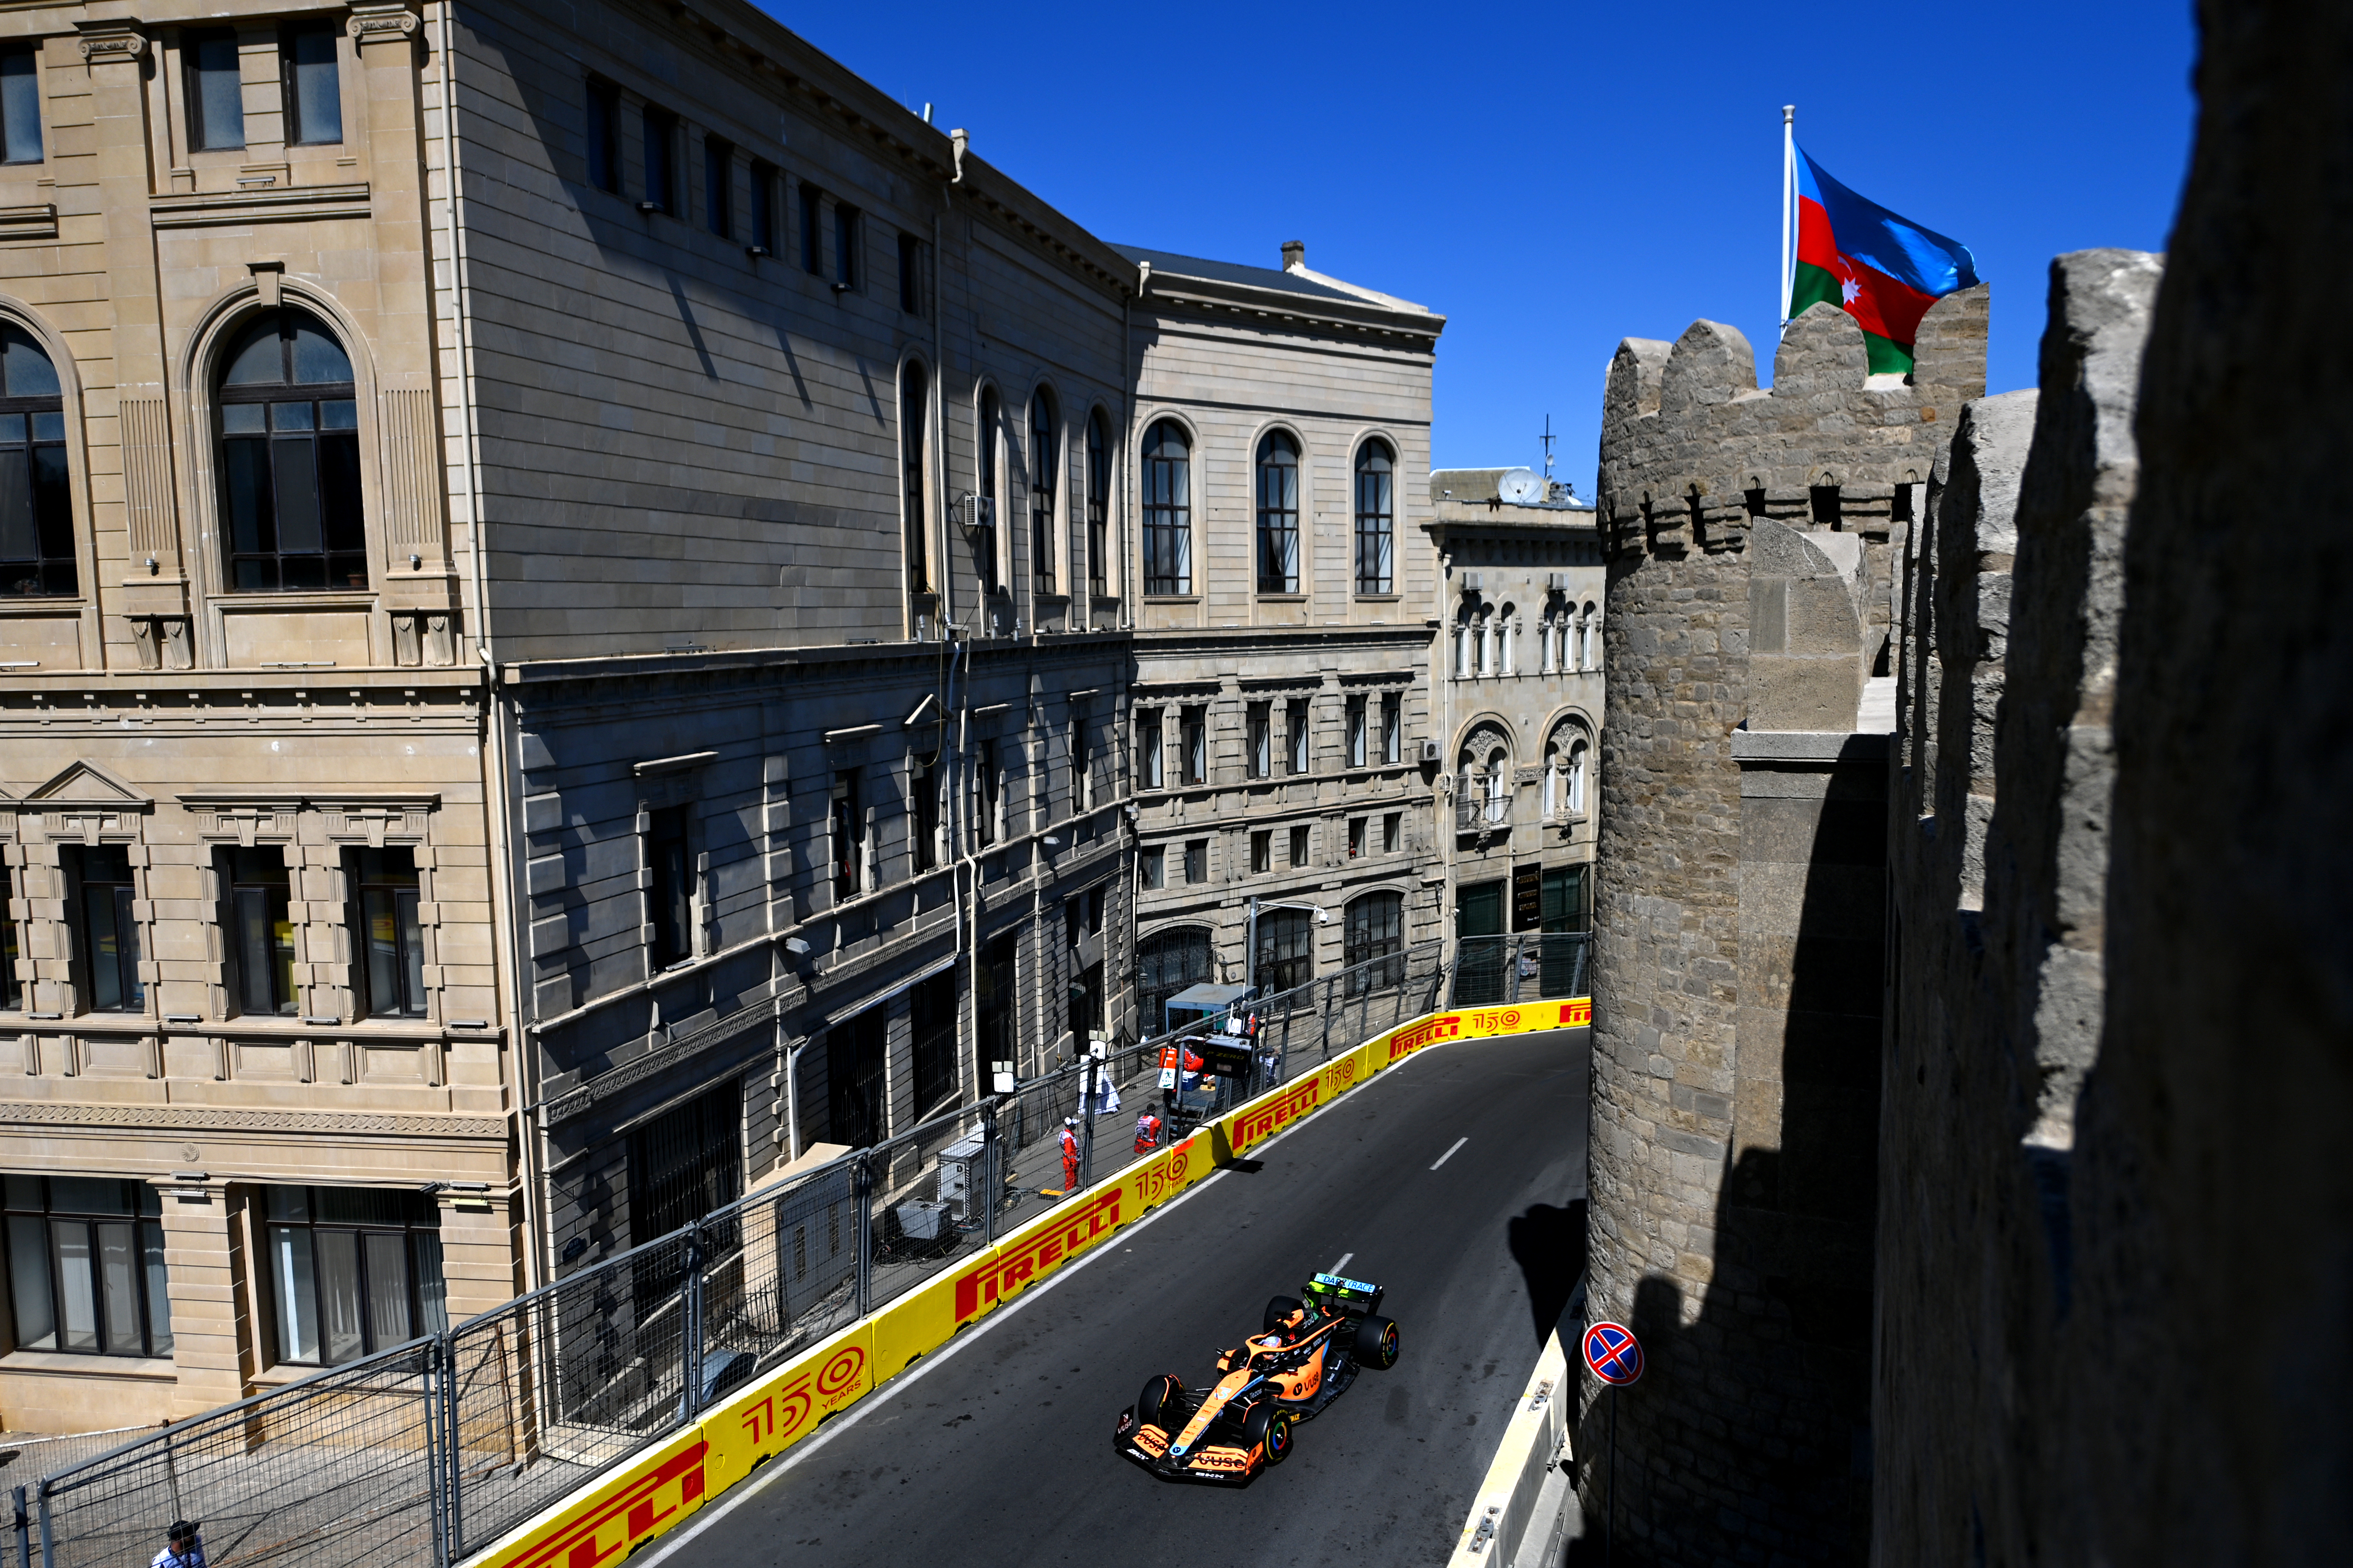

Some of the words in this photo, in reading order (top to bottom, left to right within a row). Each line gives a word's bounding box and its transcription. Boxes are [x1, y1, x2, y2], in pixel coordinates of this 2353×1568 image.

[1389, 1016, 1461, 1059] PIRELLI
[1472, 1010, 1520, 1032] 150
[1326, 1058, 1354, 1091] 150
[1233, 1077, 1319, 1150] PIRELLI
[1135, 1152, 1187, 1201] 150
[1168, 1176, 1185, 1190] YEARS
[955, 1188, 1122, 1323] PIRELLI
[742, 1346, 864, 1445] 150
[822, 1380, 861, 1410] YEARS
[1214, 1387, 1232, 1399] 3
[1250, 1388, 1262, 1399] Tezos
